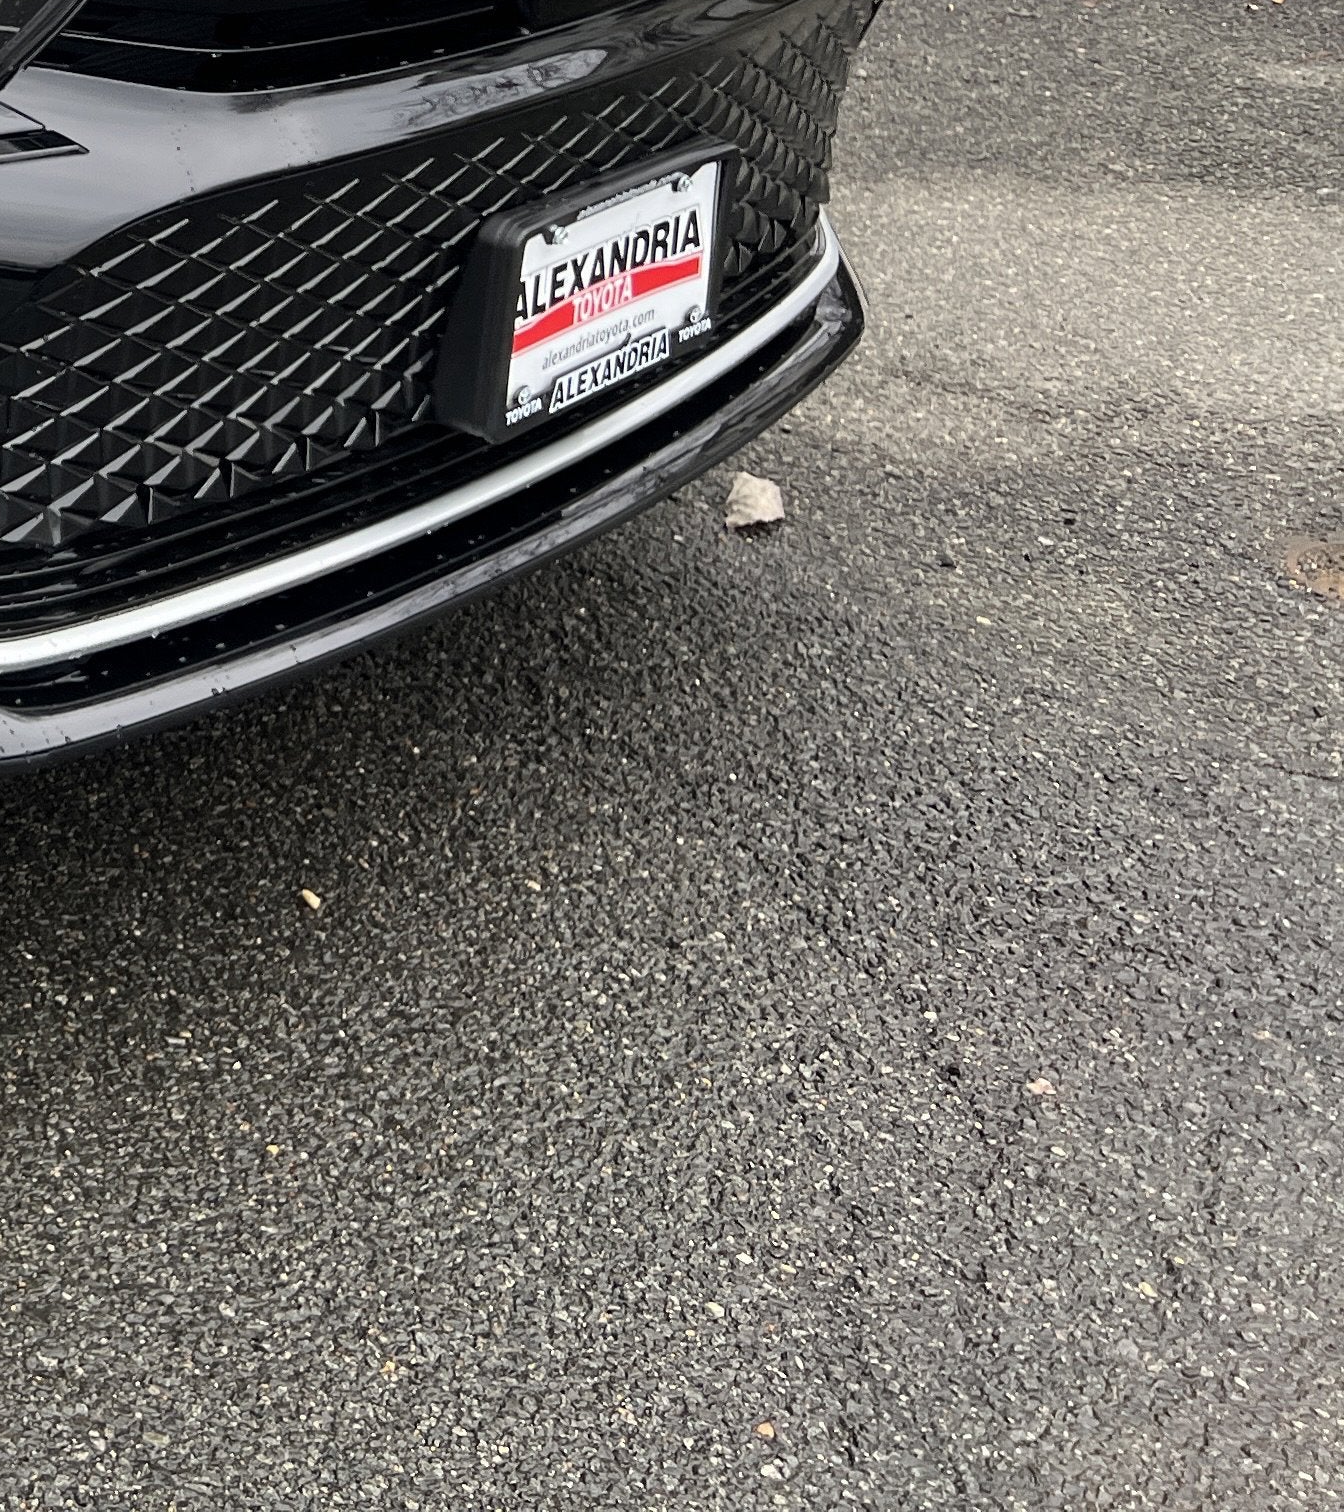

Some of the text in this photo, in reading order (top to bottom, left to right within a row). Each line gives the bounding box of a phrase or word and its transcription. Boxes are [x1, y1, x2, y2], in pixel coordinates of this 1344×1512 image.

[513, 209, 701, 320] ALEXANDRIA
[573, 274, 633, 324] TOYOTA
[541, 308, 656, 371] alexandriatoyota.com
[678, 317, 712, 343] TOYOTA
[552, 329, 668, 410] ALEXANDRIA
[505, 396, 543, 427] TOYOTA
